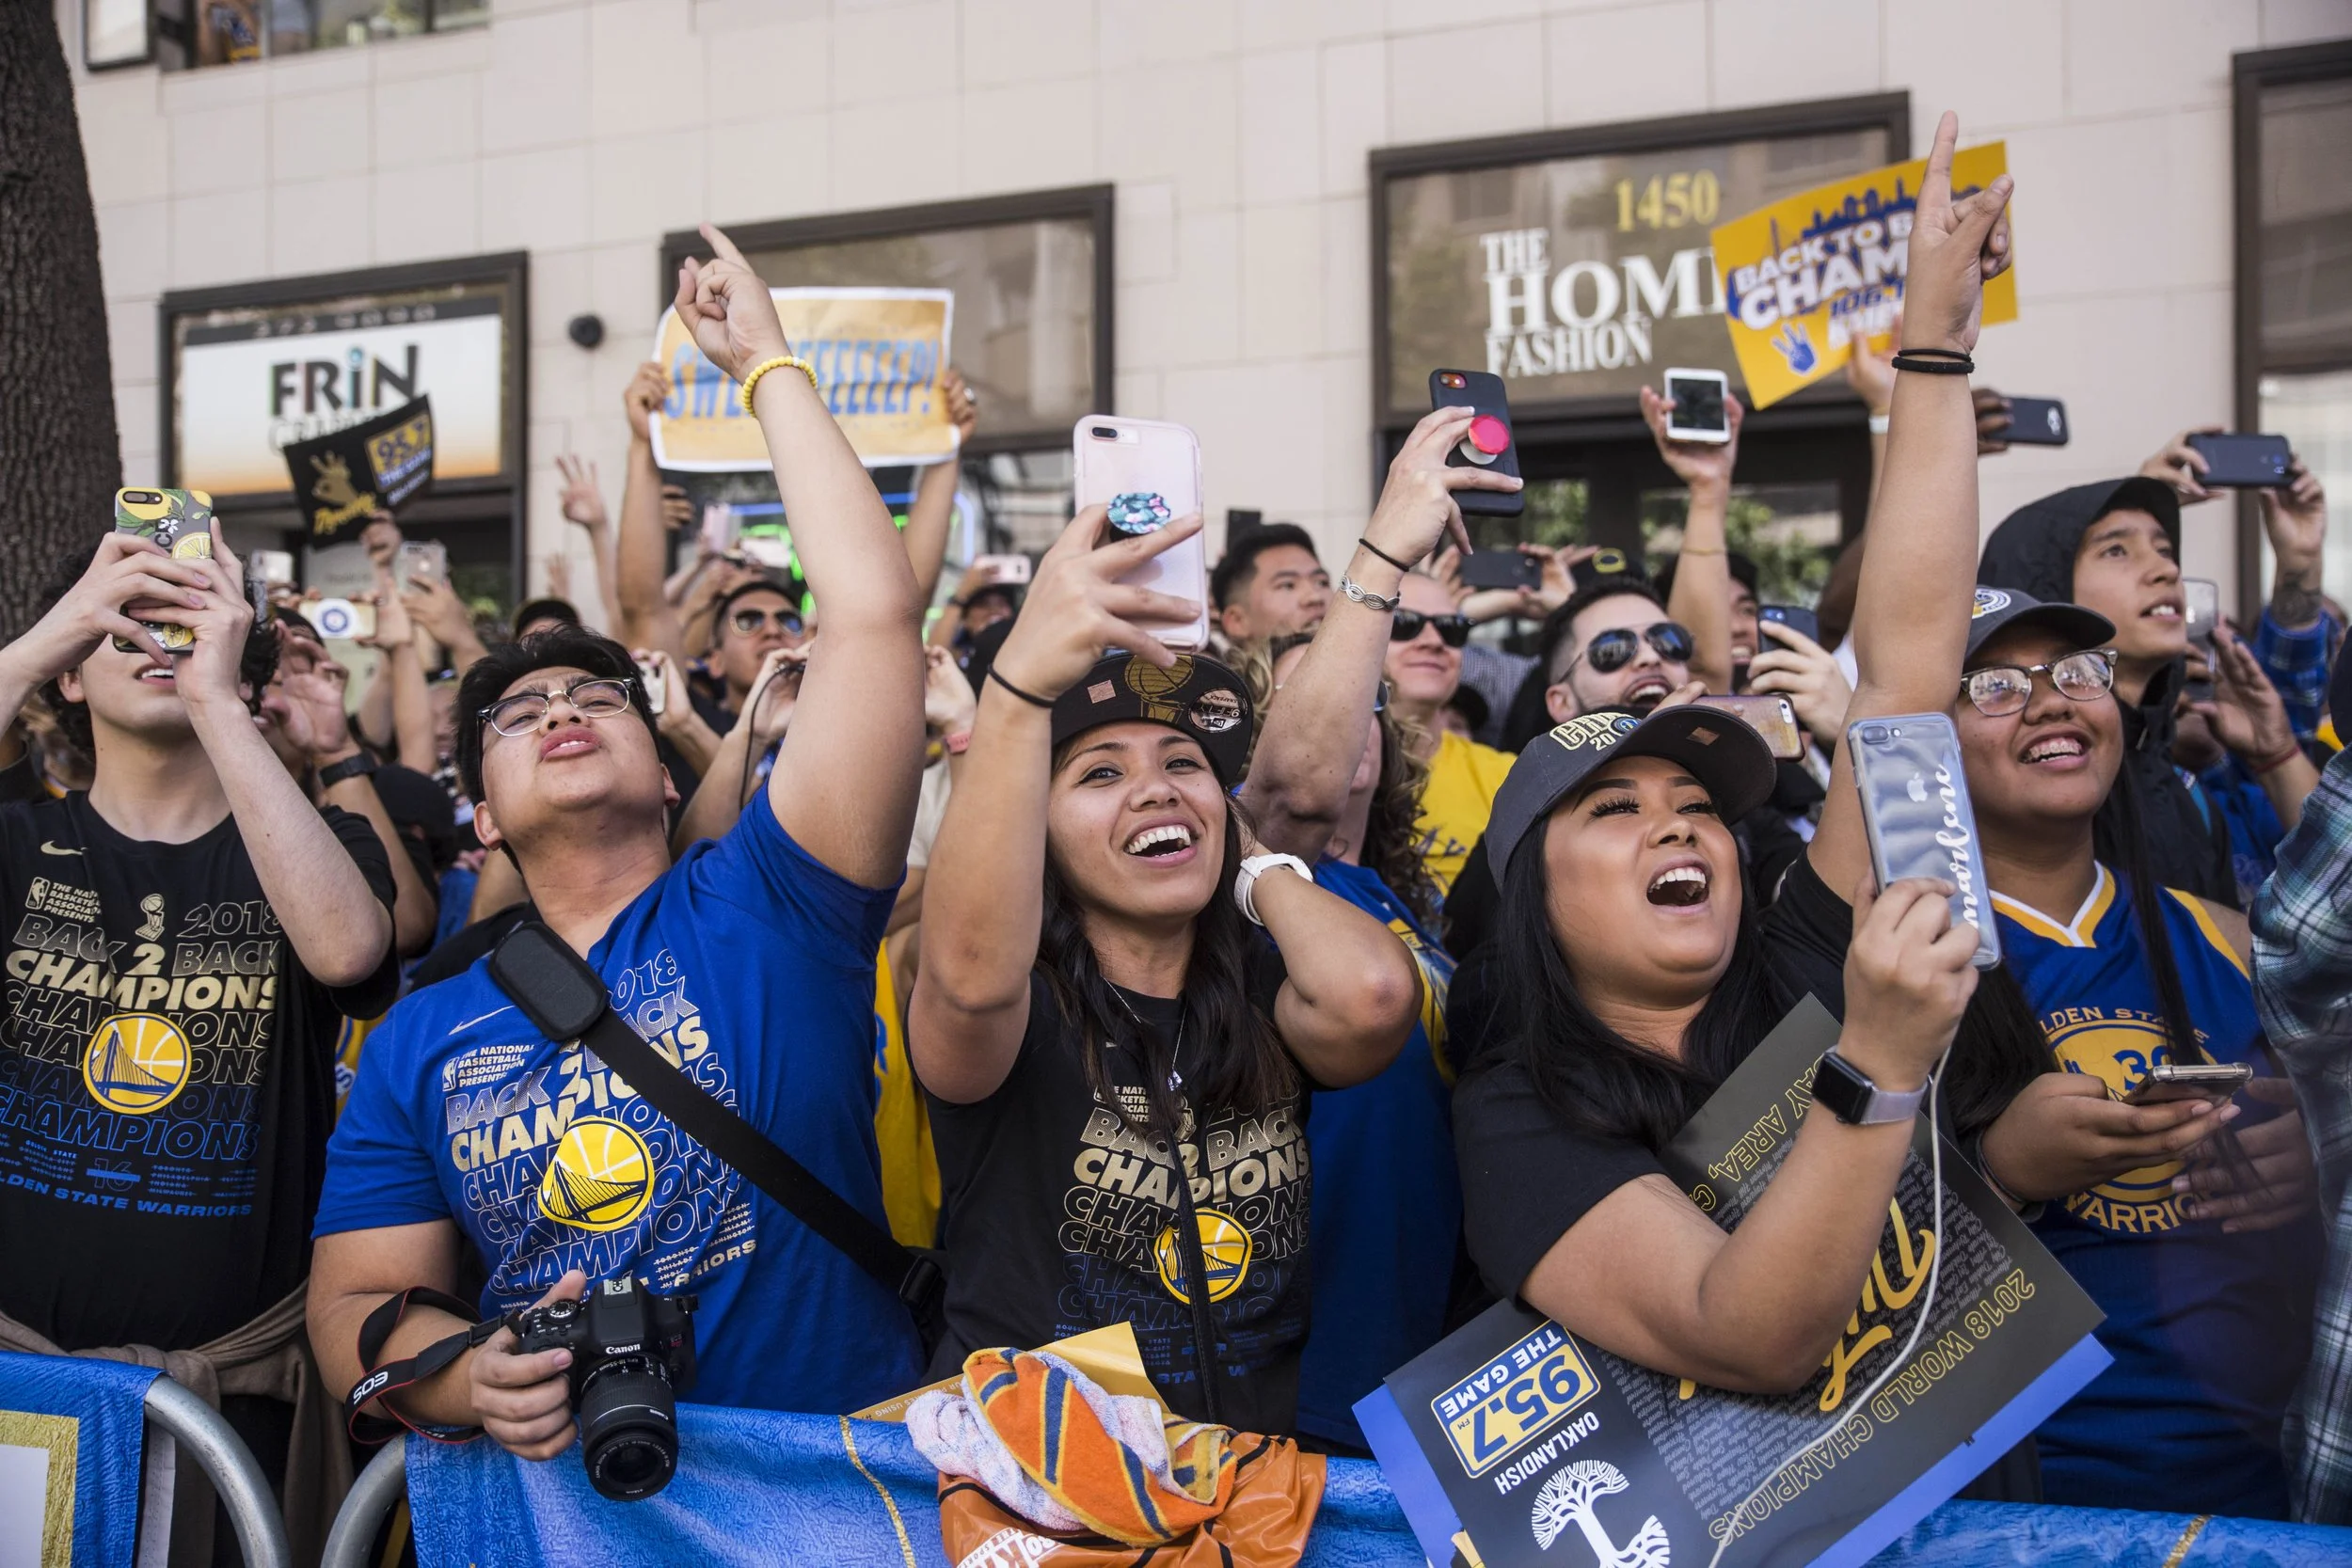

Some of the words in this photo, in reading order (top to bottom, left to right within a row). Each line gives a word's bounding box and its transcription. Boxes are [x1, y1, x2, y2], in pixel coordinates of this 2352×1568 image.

[1615, 171, 1720, 232] 1450
[1480, 230, 1549, 273] THE
[1734, 236, 1827, 294] BACK
[1830, 221, 1883, 253] TO
[1740, 241, 1909, 330] CHAM
[1485, 313, 1653, 376] FASHION
[1590, 734, 1616, 751] 20
[53, 882, 72, 893] THE
[44, 905, 95, 923] PRESENTS
[12, 912, 128, 974] BACK
[124, 942, 166, 975] 2
[171, 941, 280, 976] BACK
[6, 950, 278, 1010] CHAMPIONS
[608, 949, 678, 1011] 018
[2039, 1006, 2105, 1036] LDEN
[457, 1059, 525, 1079] ASSOCIATION
[458, 1053, 521, 1069] BASKETBALL
[480, 1044, 534, 1056] NATIONAL
[446, 1066, 551, 1134] BACK
[559, 1053, 584, 1098] 2
[1206, 1105, 1304, 1172] BACK
[1708, 1103, 1786, 1181] AREA,
[55, 1188, 130, 1210] STATE
[136, 1200, 252, 1218] WARRIORS
[653, 1246, 699, 1265] TORONTO
[1960, 1268, 2038, 1342] 2018
[606, 1343, 640, 1354] Canon
[1511, 1328, 1561, 1369] THE
[353, 1371, 389, 1404] EOS
[1156, 1370, 1197, 1386] STA
[1439, 1361, 1511, 1418] GAME
[1867, 1330, 1975, 1422] WORLD
[875, 1402, 904, 1417] USING
[1456, 1418, 1470, 1430] FM
[1472, 1346, 1584, 1464] 95.7
[1492, 1410, 1600, 1495] OAKLANDISH
[1707, 1412, 1874, 1548] CHAMPIONS
